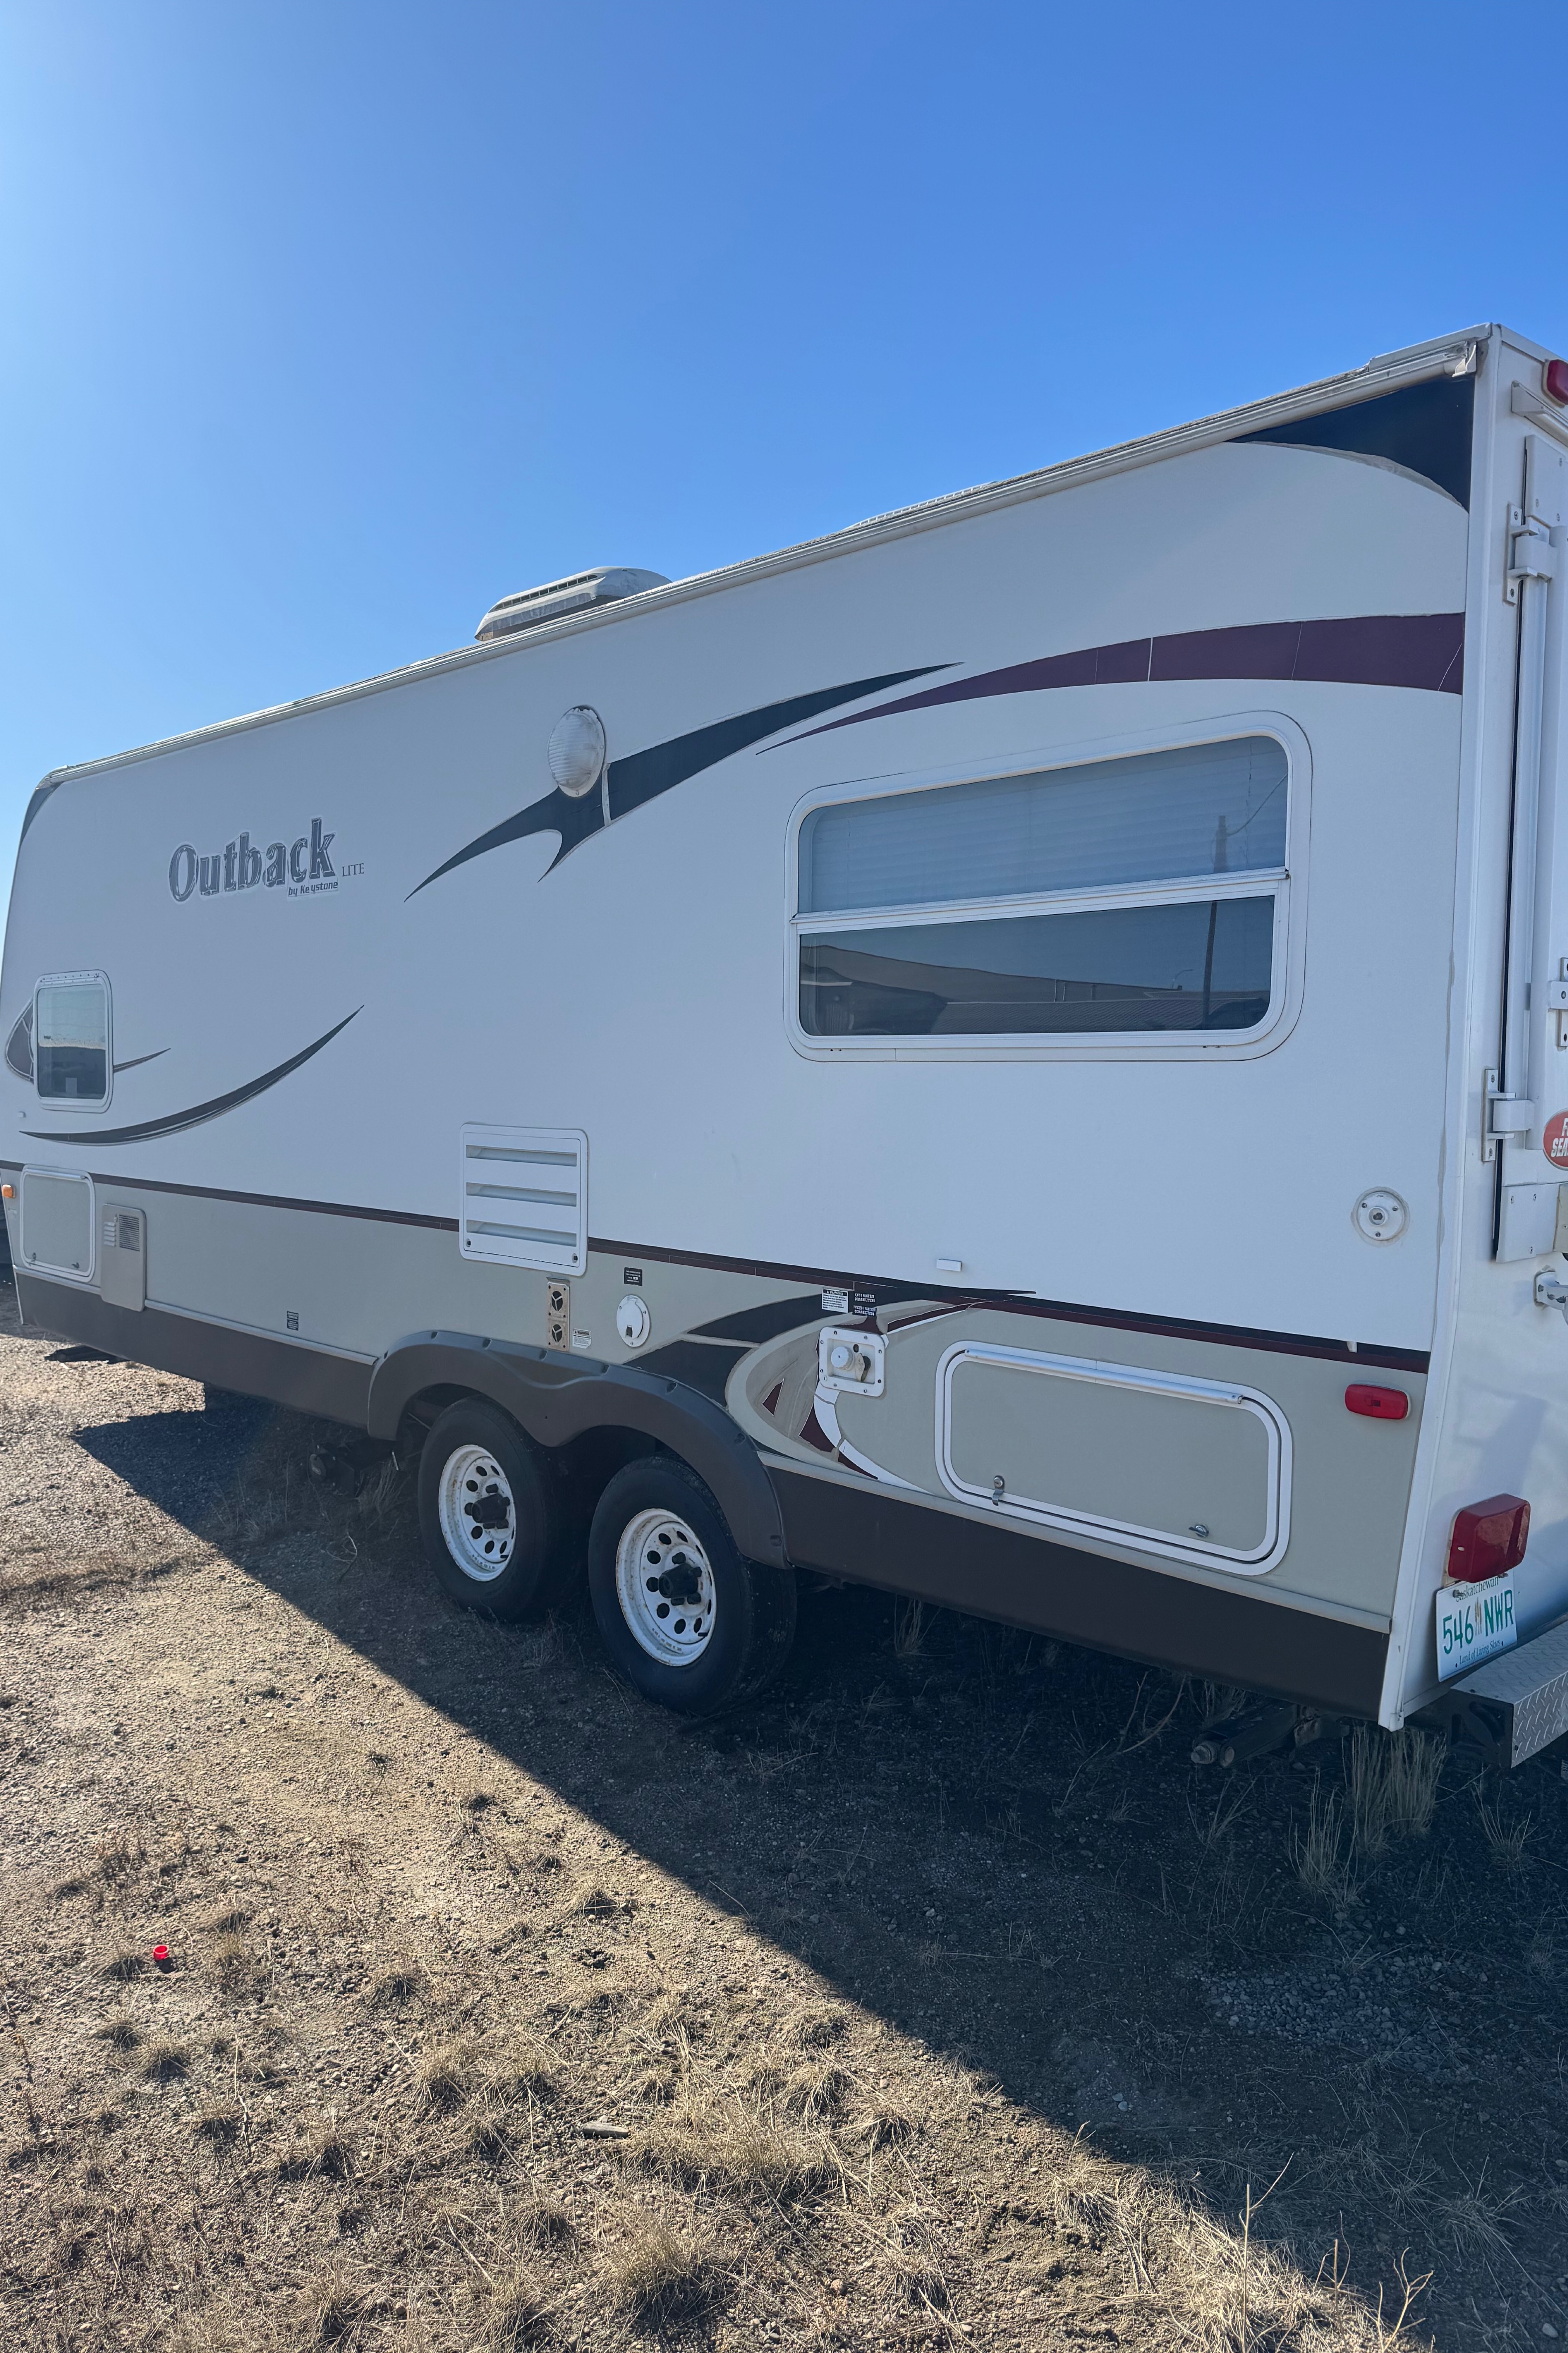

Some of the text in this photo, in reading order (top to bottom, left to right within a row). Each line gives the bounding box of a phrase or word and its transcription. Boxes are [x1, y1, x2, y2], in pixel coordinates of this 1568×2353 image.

[169, 817, 336, 902] Outback
[342, 863, 365, 877] LITE
[288, 882, 338, 896] by Keystone
[1551, 1137, 1568, 1157] SEA
[1443, 1589, 1514, 1654] 546 NWR
[1460, 1651, 1470, 1664] Land
[1471, 1648, 1475, 1660] of
